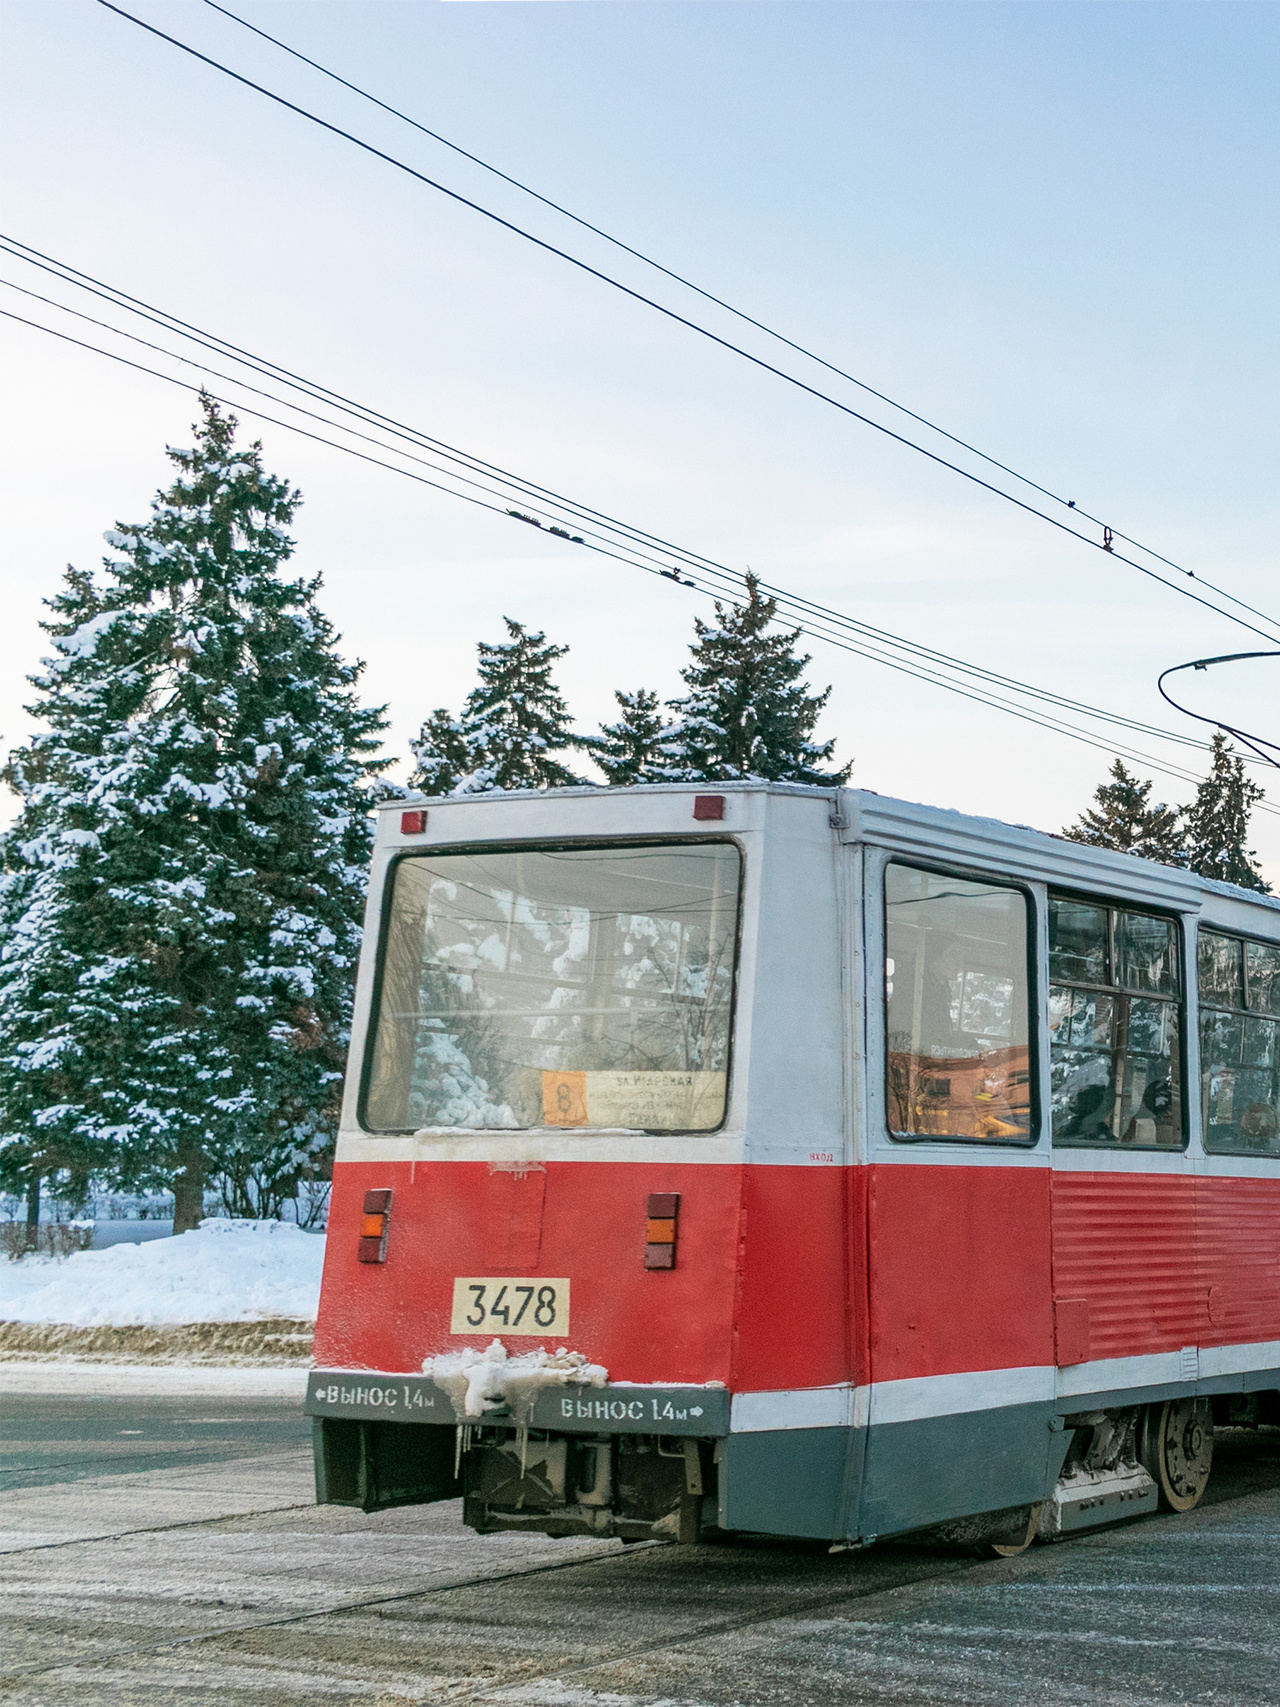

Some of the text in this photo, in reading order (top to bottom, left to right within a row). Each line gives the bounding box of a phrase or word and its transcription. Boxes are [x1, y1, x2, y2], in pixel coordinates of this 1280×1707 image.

[556, 1082, 571, 1114] 8
[809, 1152, 833, 1162] ВХОД
[466, 1284, 556, 1327] 3478
[326, 1385, 398, 1406] ВЫНОС
[561, 1398, 644, 1420] ВЫНОС
